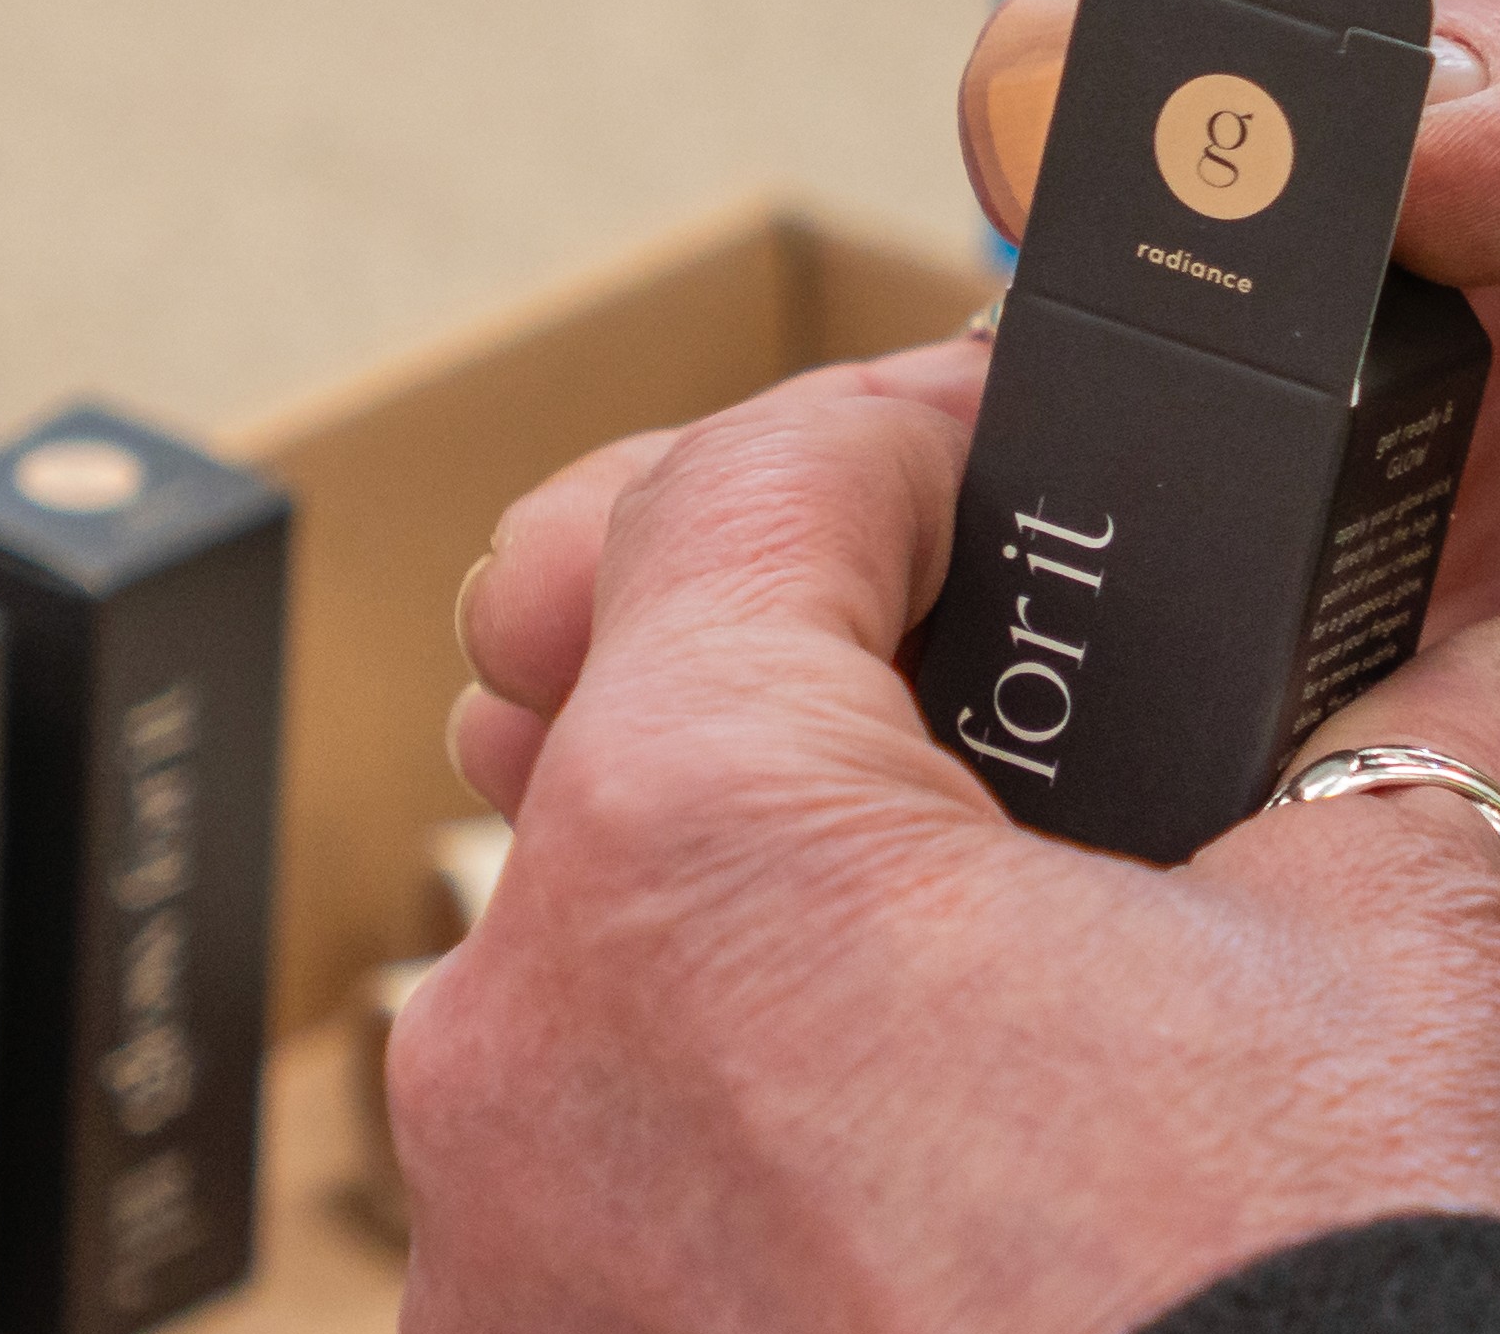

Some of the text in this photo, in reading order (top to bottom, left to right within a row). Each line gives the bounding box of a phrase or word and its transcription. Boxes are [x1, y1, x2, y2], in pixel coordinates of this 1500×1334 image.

[1196, 108, 1255, 189] g
[1135, 238, 1254, 295] radiance
[956, 495, 1115, 788] for it
